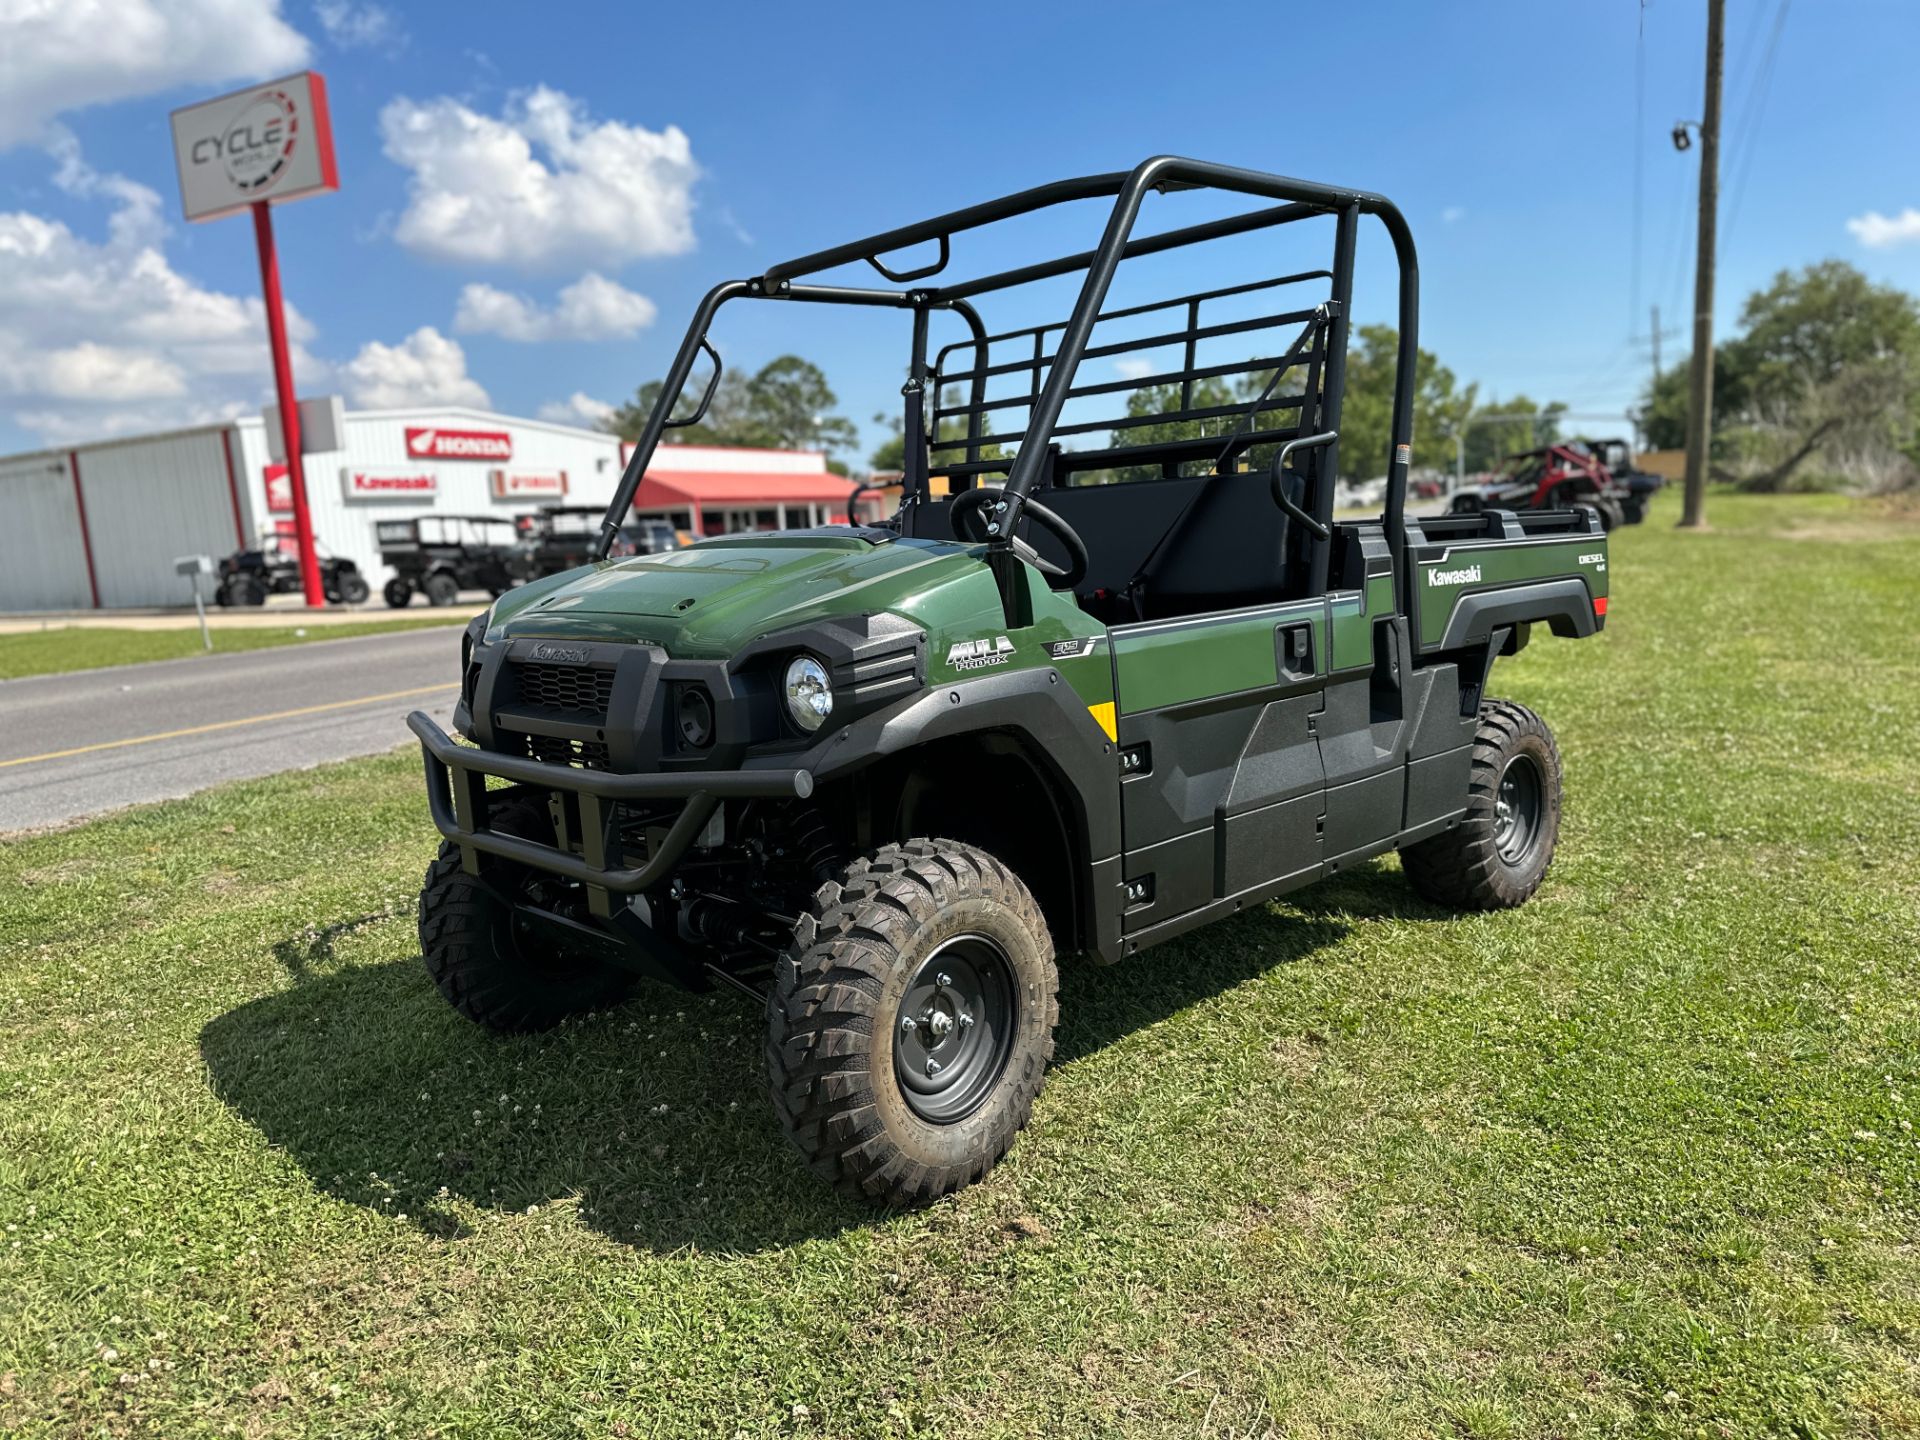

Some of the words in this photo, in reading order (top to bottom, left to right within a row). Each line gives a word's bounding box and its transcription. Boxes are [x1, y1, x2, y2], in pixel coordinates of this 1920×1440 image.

[191, 118, 282, 165] CYCLE
[436, 435, 511, 456] HONDA
[354, 473, 437, 490] Kawasaki
[1578, 553, 1606, 565] DIESEL
[1428, 565, 1482, 587] Kawasaki
[529, 643, 593, 662] Kawasaki
